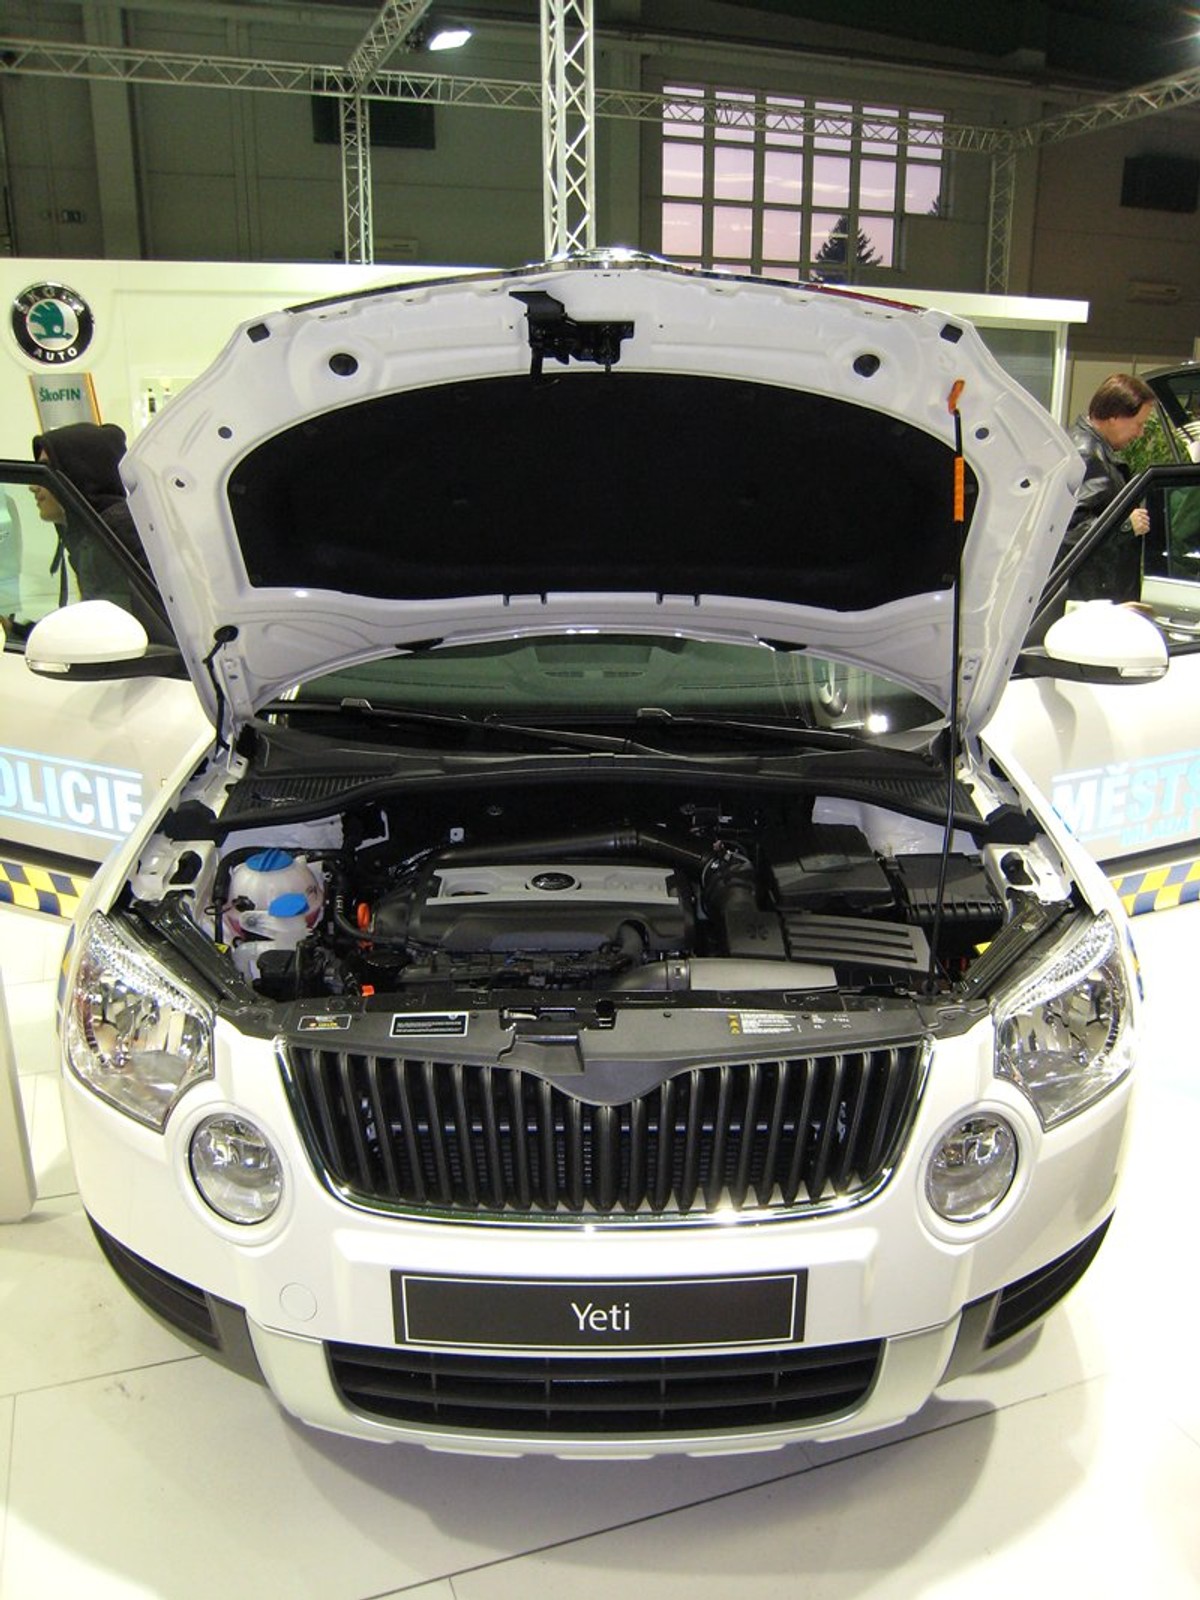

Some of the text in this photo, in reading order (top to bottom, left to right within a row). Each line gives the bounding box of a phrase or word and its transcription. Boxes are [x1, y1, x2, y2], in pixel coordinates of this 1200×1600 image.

[33, 347, 78, 362] AUTO
[39, 386, 81, 402] ŠkoFIN
[571, 1302, 630, 1331] Yeti
